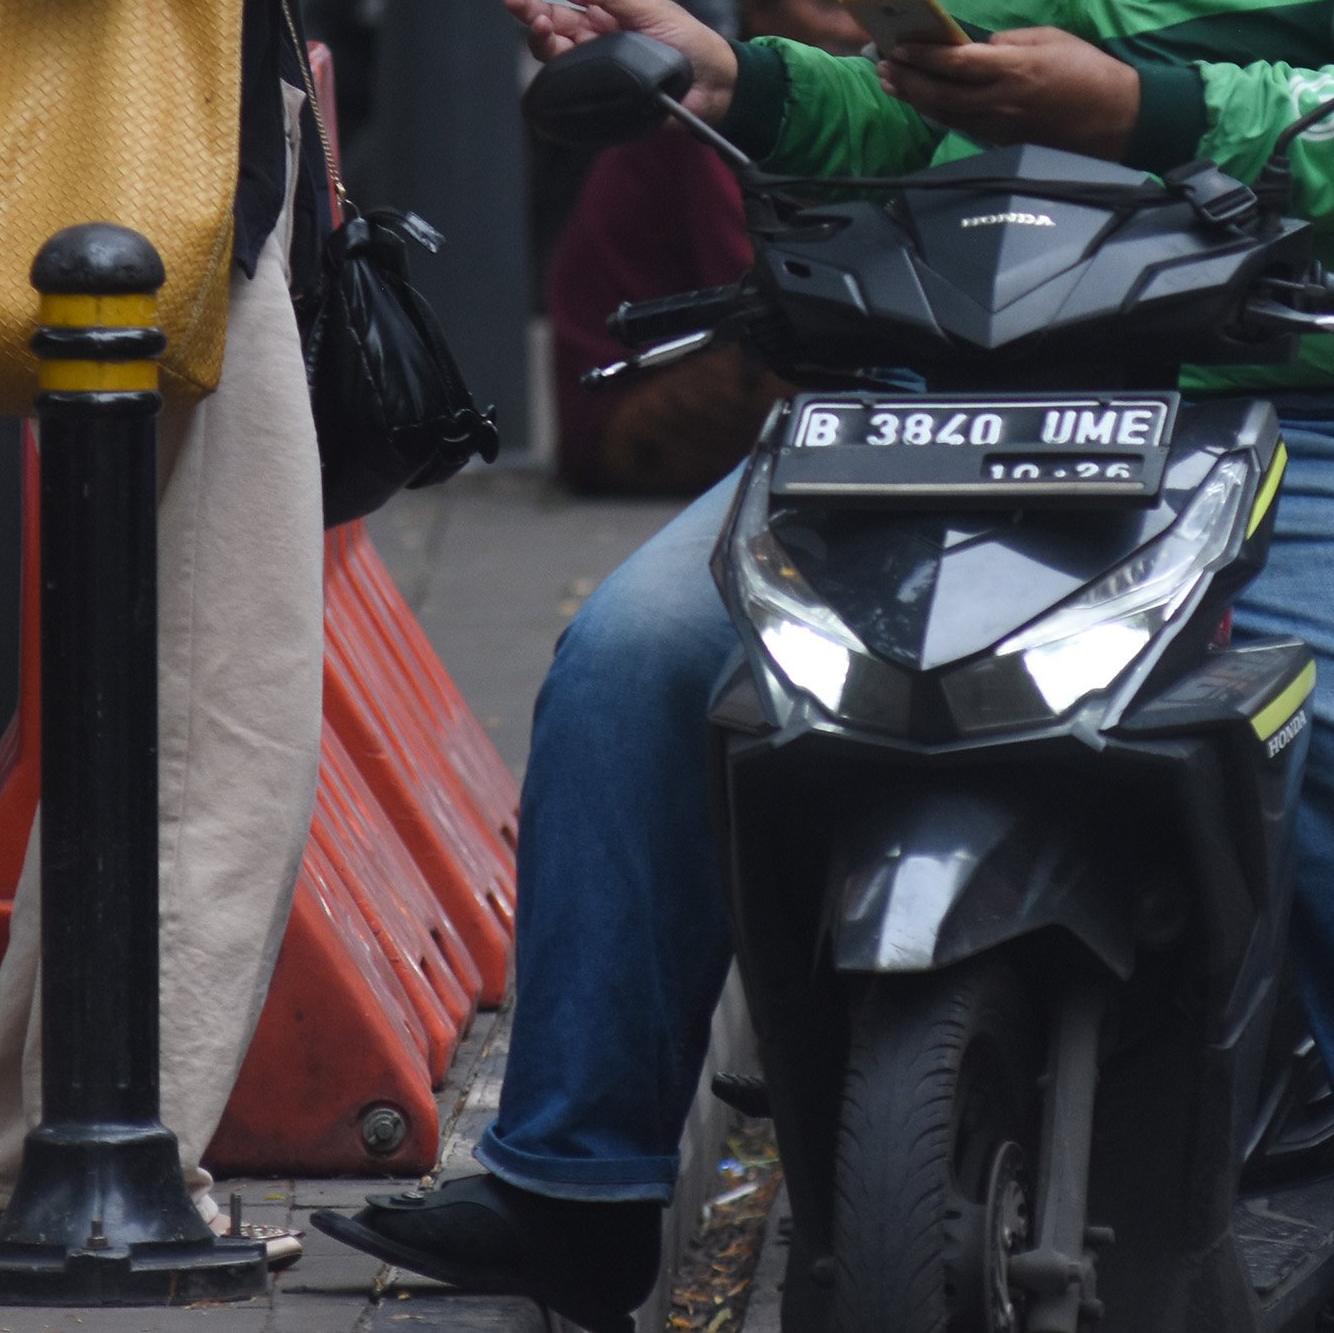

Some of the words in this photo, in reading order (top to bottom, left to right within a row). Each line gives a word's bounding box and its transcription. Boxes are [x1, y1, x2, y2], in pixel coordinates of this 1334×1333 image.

[962, 212, 1056, 226] HONDA
[806, 412, 840, 446] B
[867, 412, 1003, 446] 3840
[1041, 410, 1153, 444] UME
[1268, 709, 1307, 759] HONDA
